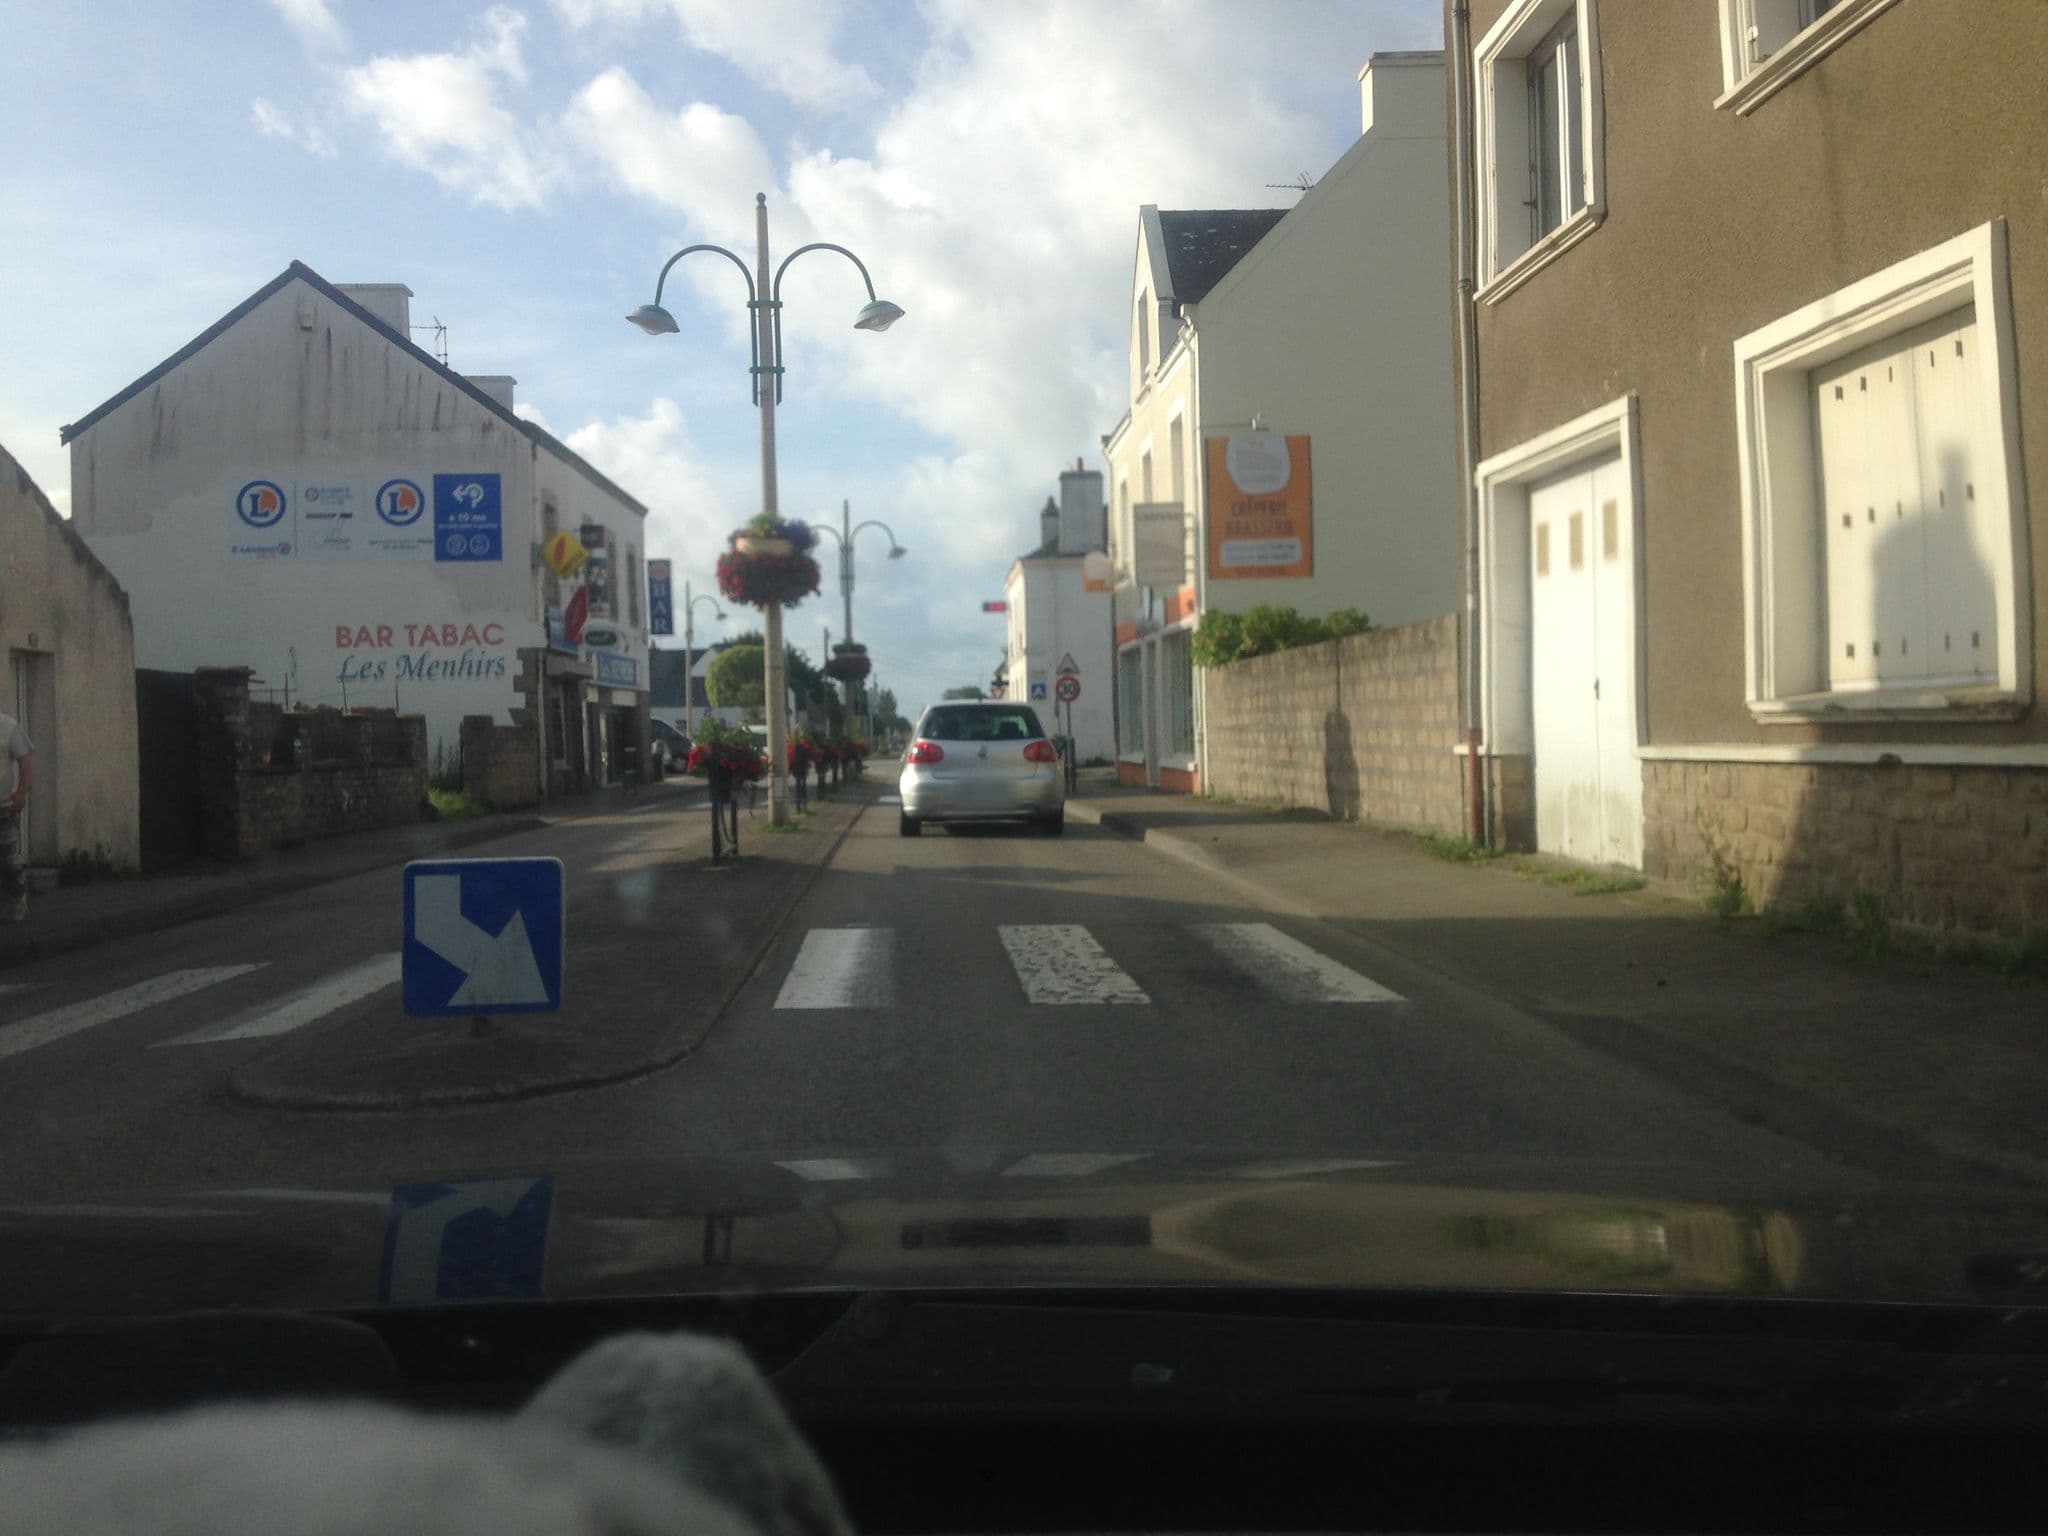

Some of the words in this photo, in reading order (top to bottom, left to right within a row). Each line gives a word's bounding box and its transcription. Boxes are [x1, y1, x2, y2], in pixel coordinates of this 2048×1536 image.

[336, 624, 394, 648] BAR
[404, 623, 505, 648] TABAC
[336, 654, 387, 682] Les
[395, 648, 506, 681] Menhirs
